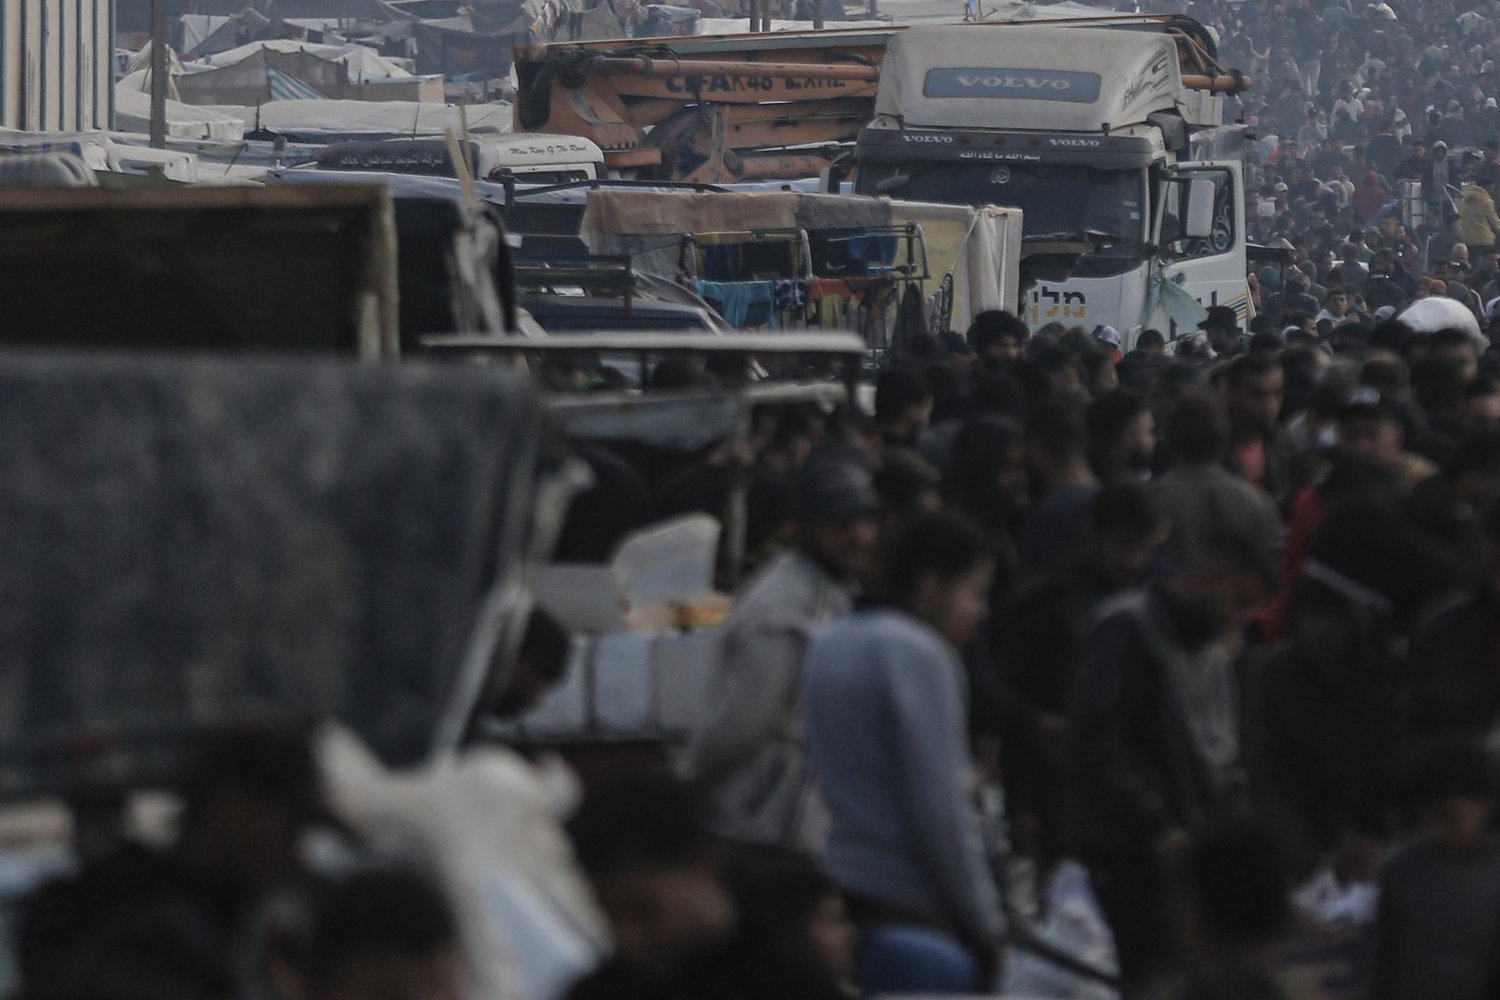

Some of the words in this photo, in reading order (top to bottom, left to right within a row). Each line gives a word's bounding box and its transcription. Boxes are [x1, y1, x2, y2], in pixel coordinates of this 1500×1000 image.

[958, 76, 1071, 90] VOLVO
[903, 135, 954, 144] VOLVO
[1050, 138, 1101, 147] VOLVO
